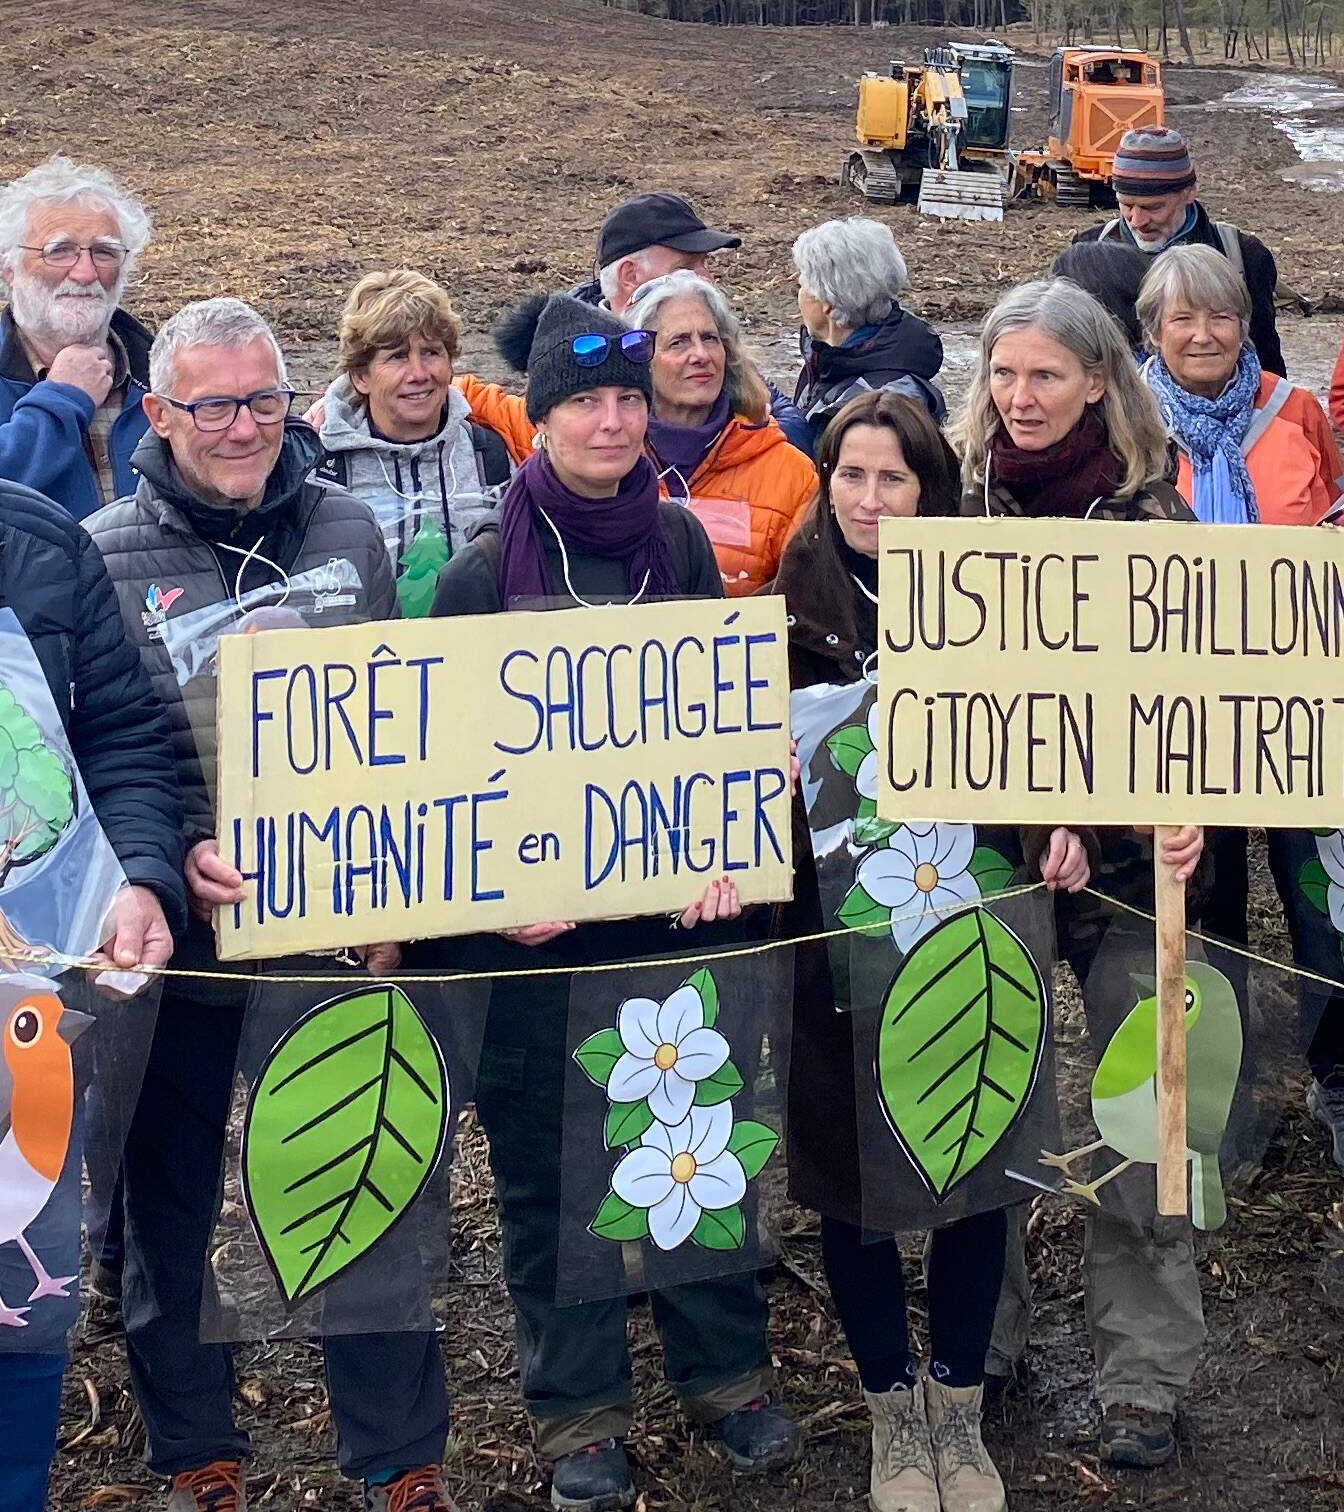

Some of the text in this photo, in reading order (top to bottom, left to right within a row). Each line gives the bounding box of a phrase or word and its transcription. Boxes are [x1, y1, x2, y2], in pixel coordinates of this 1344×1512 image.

[251, 610, 783, 778] FORÊT SACCAGÉE
[517, 832, 560, 865] en
[584, 767, 786, 891] DANGER
